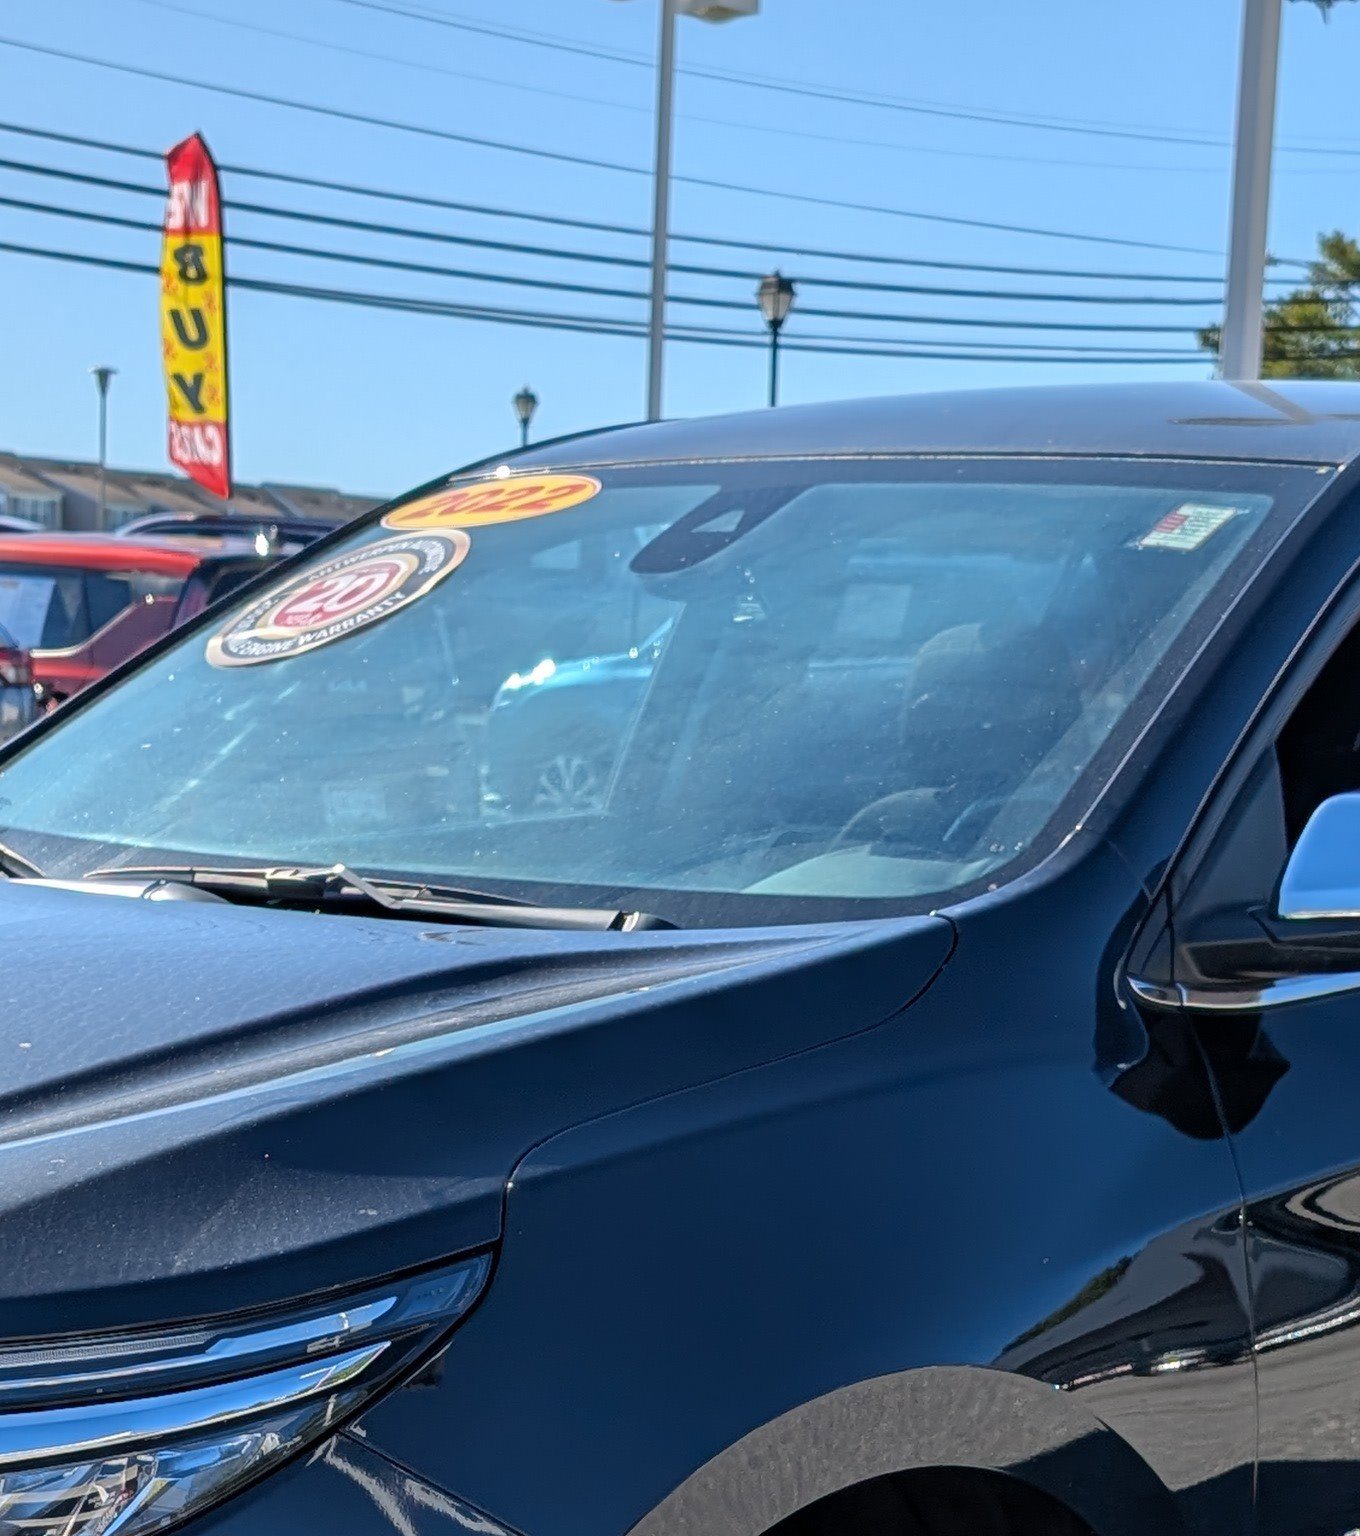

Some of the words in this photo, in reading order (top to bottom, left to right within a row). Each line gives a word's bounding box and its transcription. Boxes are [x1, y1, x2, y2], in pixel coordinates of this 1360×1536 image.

[401, 482, 589, 521] 2022
[283, 571, 390, 614] 20
[298, 592, 405, 645] WARRANTY
